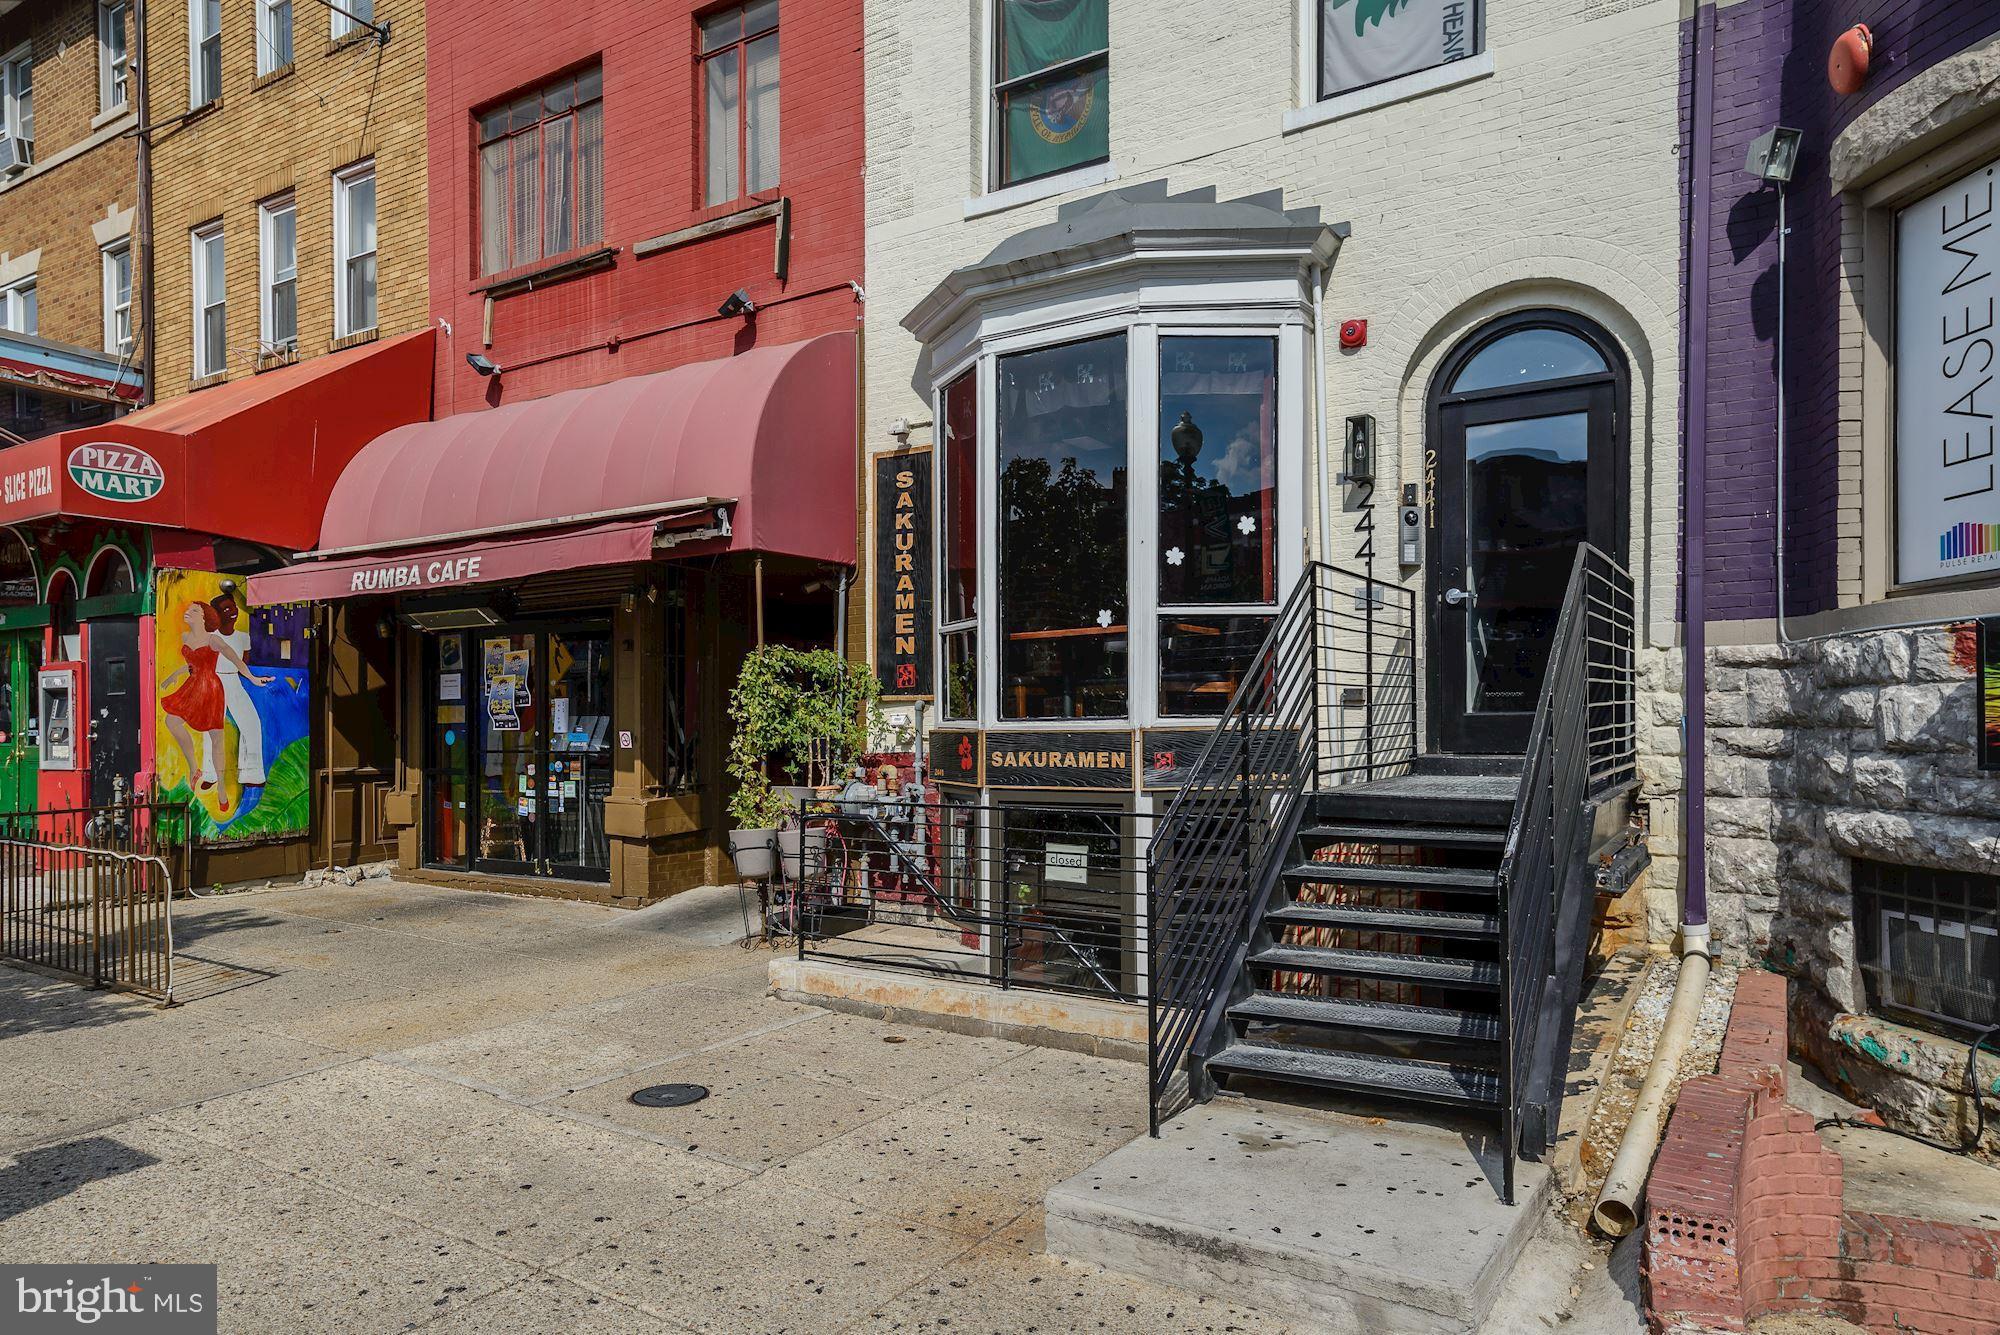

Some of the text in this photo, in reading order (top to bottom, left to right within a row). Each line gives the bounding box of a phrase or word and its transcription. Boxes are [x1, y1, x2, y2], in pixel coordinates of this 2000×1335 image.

[82, 446, 157, 476] PIZZA
[4, 466, 52, 504] SLICE PIZZA
[82, 471, 154, 497] MART
[1425, 449, 1437, 529] 2441
[351, 556, 482, 591] RUMBA CAFE
[895, 471, 915, 655] SAKURAMEN
[1940, 557, 1967, 568] PULSE
[991, 751, 1126, 769] SAKURAMEN
[1050, 853, 1082, 868] closed
